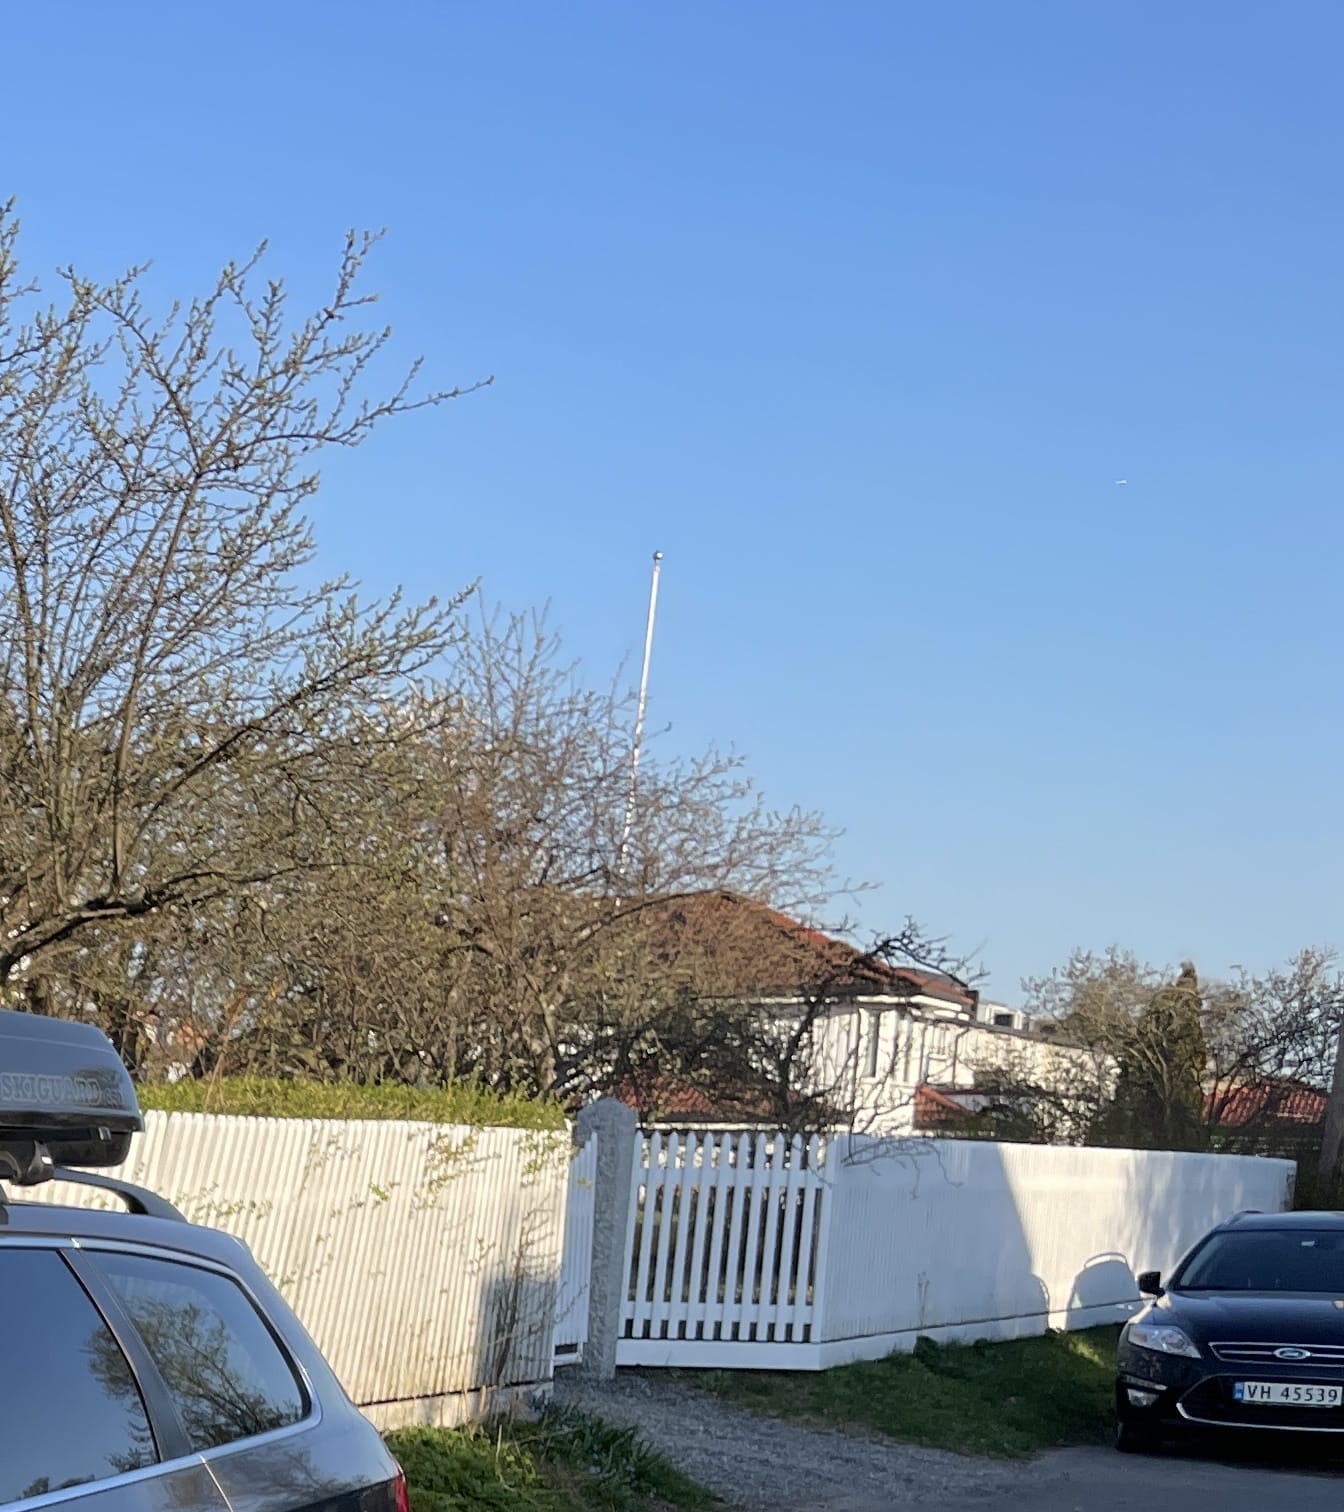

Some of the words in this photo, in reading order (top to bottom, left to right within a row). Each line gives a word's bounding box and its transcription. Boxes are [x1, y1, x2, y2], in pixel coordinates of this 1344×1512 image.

[0, 1072, 101, 1105] SKIGUARD
[1247, 1384, 1271, 1400] VH
[1280, 1387, 1338, 1402] 45539
